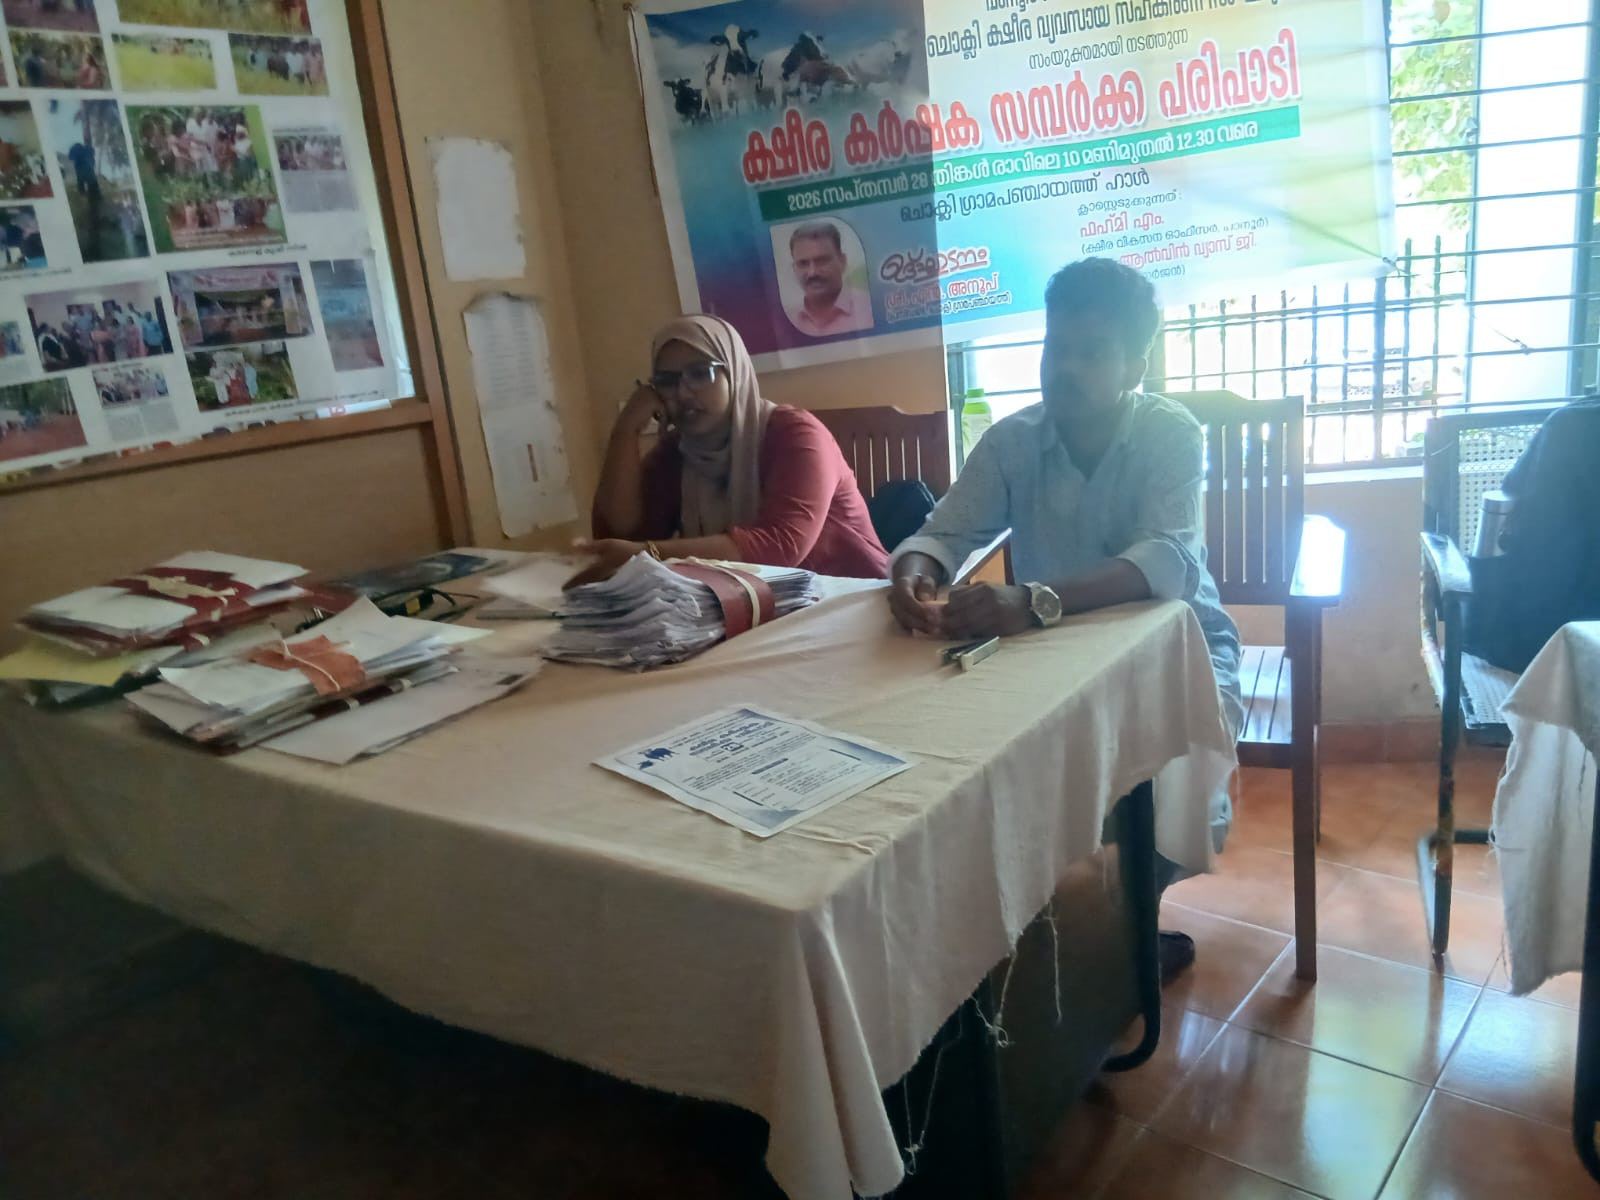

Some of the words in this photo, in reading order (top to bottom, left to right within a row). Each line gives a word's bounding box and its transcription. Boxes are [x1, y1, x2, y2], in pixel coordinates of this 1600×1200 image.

[926, 19, 981, 59] ചൊക്ലി
[986, 12, 1032, 47] ക്ഷീര
[1037, 4, 1110, 44] വ്യവസായ
[1029, 34, 1123, 69] സംയുക്തമായി
[1126, 28, 1188, 54] നടത്തുന്ന
[742, 107, 831, 184] ക്ഷീര
[844, 100, 981, 166] കർഷക
[989, 69, 1144, 143] സമ്പർക്ക
[1158, 27, 1300, 118] പരിപാടി
[788, 192, 821, 211] 2026
[911, 172, 929, 190] 28
[933, 156, 989, 187] തിങ്കൾ
[992, 151, 1061, 177] രാവിലെ
[1063, 151, 1080, 169] 10
[1084, 134, 1175, 166] മണിമുതൽ
[1176, 129, 1215, 151] 12.30
[1217, 119, 1258, 145] വരെ
[900, 194, 957, 224] ചൊക്ലി
[959, 171, 1101, 216] ഗ്രാമപഞ്ചായത്ത്
[1105, 167, 1151, 196] ഹാൾ
[948, 273, 998, 296] അനൂപ്
